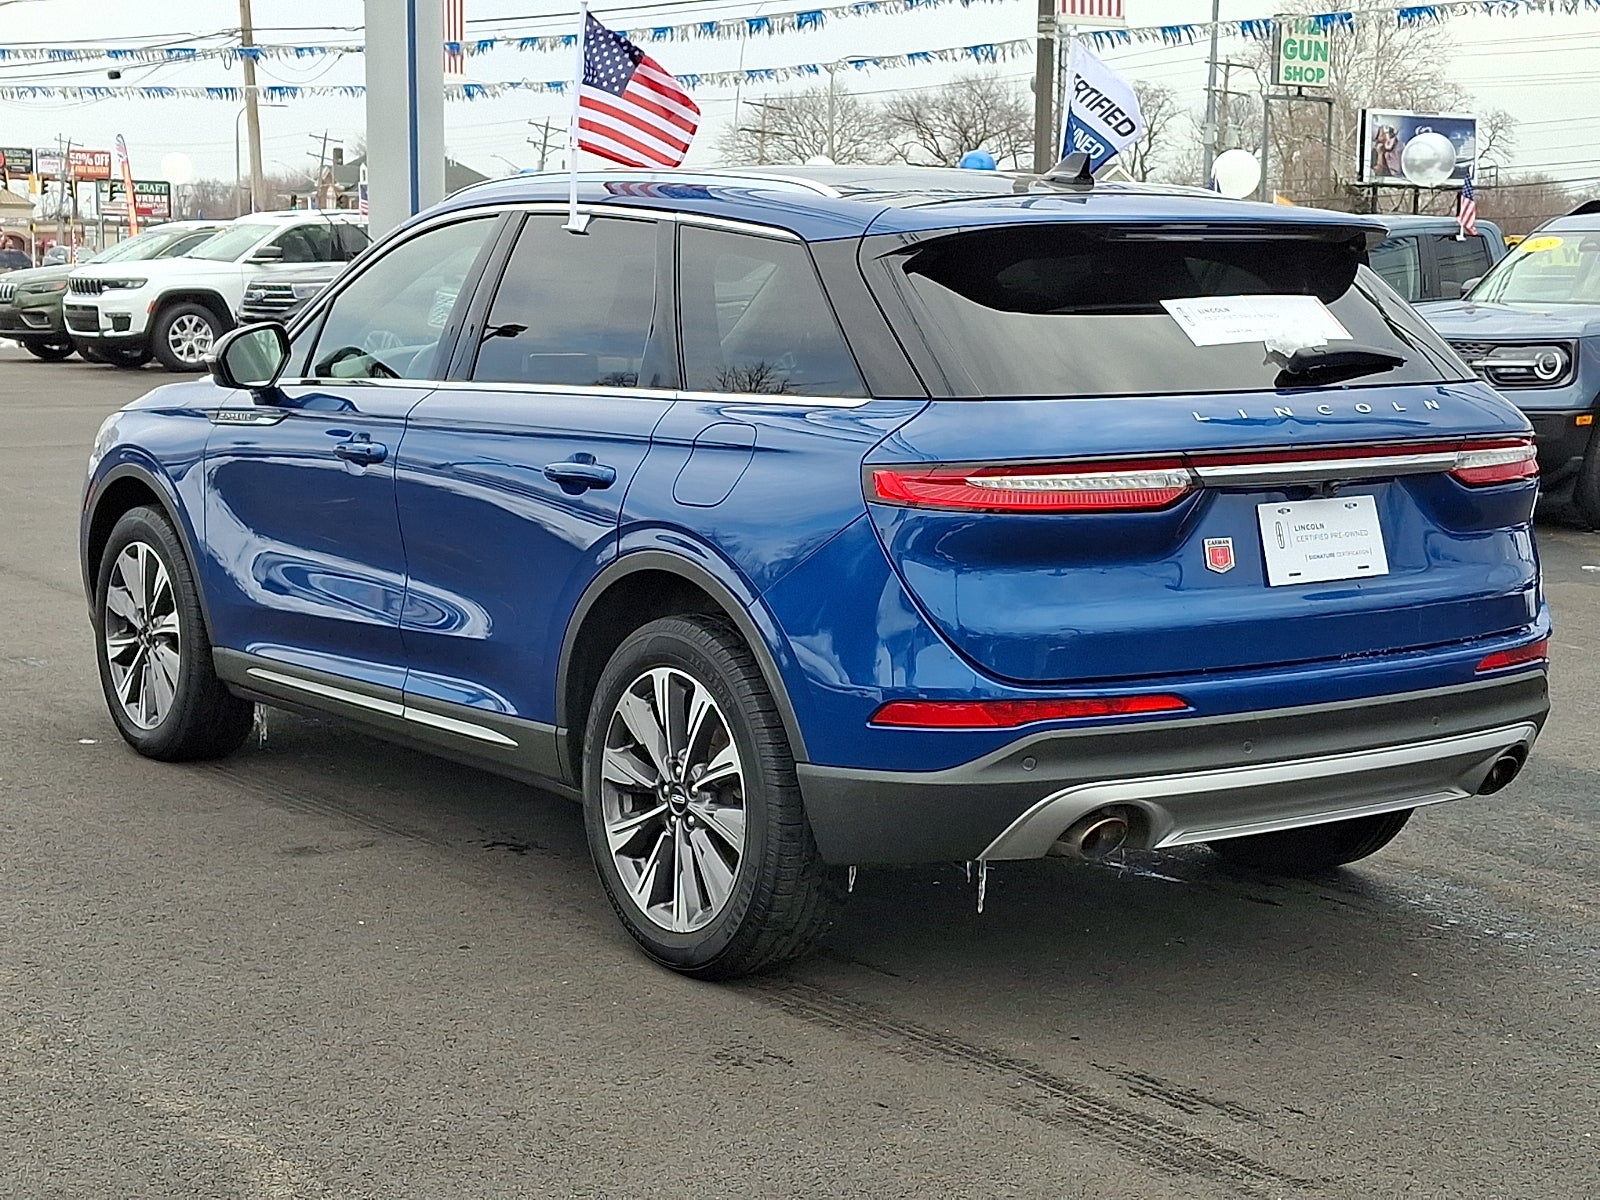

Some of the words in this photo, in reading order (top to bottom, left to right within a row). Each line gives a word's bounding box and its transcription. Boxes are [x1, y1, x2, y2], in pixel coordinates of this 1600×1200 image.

[1283, 38, 1328, 62] GUN
[1284, 65, 1325, 83] SHOP
[70, 153, 93, 166] 50%
[94, 153, 110, 166] OFF
[1192, 399, 1440, 422] LINCOLN
[1294, 522, 1325, 532] LINCOLN
[1296, 532, 1329, 543] CERTIFIED
[1330, 529, 1369, 540] PRE-OWNED
